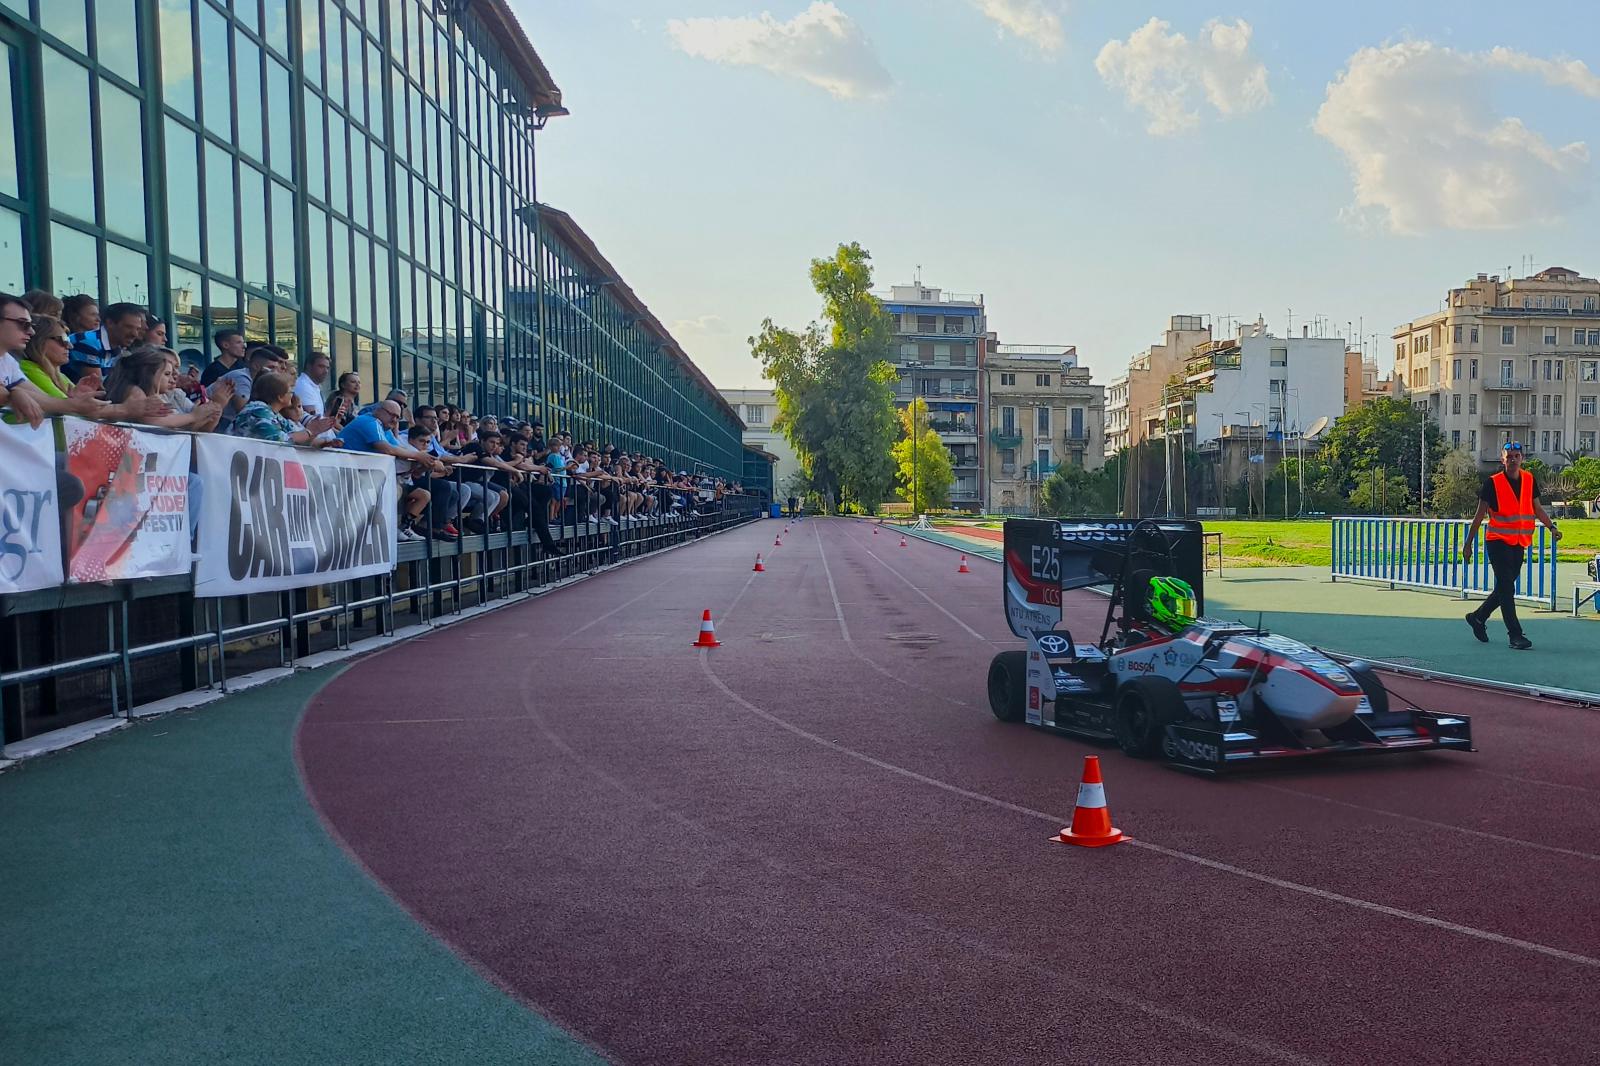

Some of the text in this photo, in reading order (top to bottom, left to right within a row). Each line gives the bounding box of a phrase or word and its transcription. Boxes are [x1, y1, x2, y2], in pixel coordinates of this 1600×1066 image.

[228, 450, 391, 581] CAR AND DRIVER
[1031, 545, 1060, 581] E25
[1024, 609, 1051, 626] ATHENS
[1127, 660, 1155, 673] BOSCH
